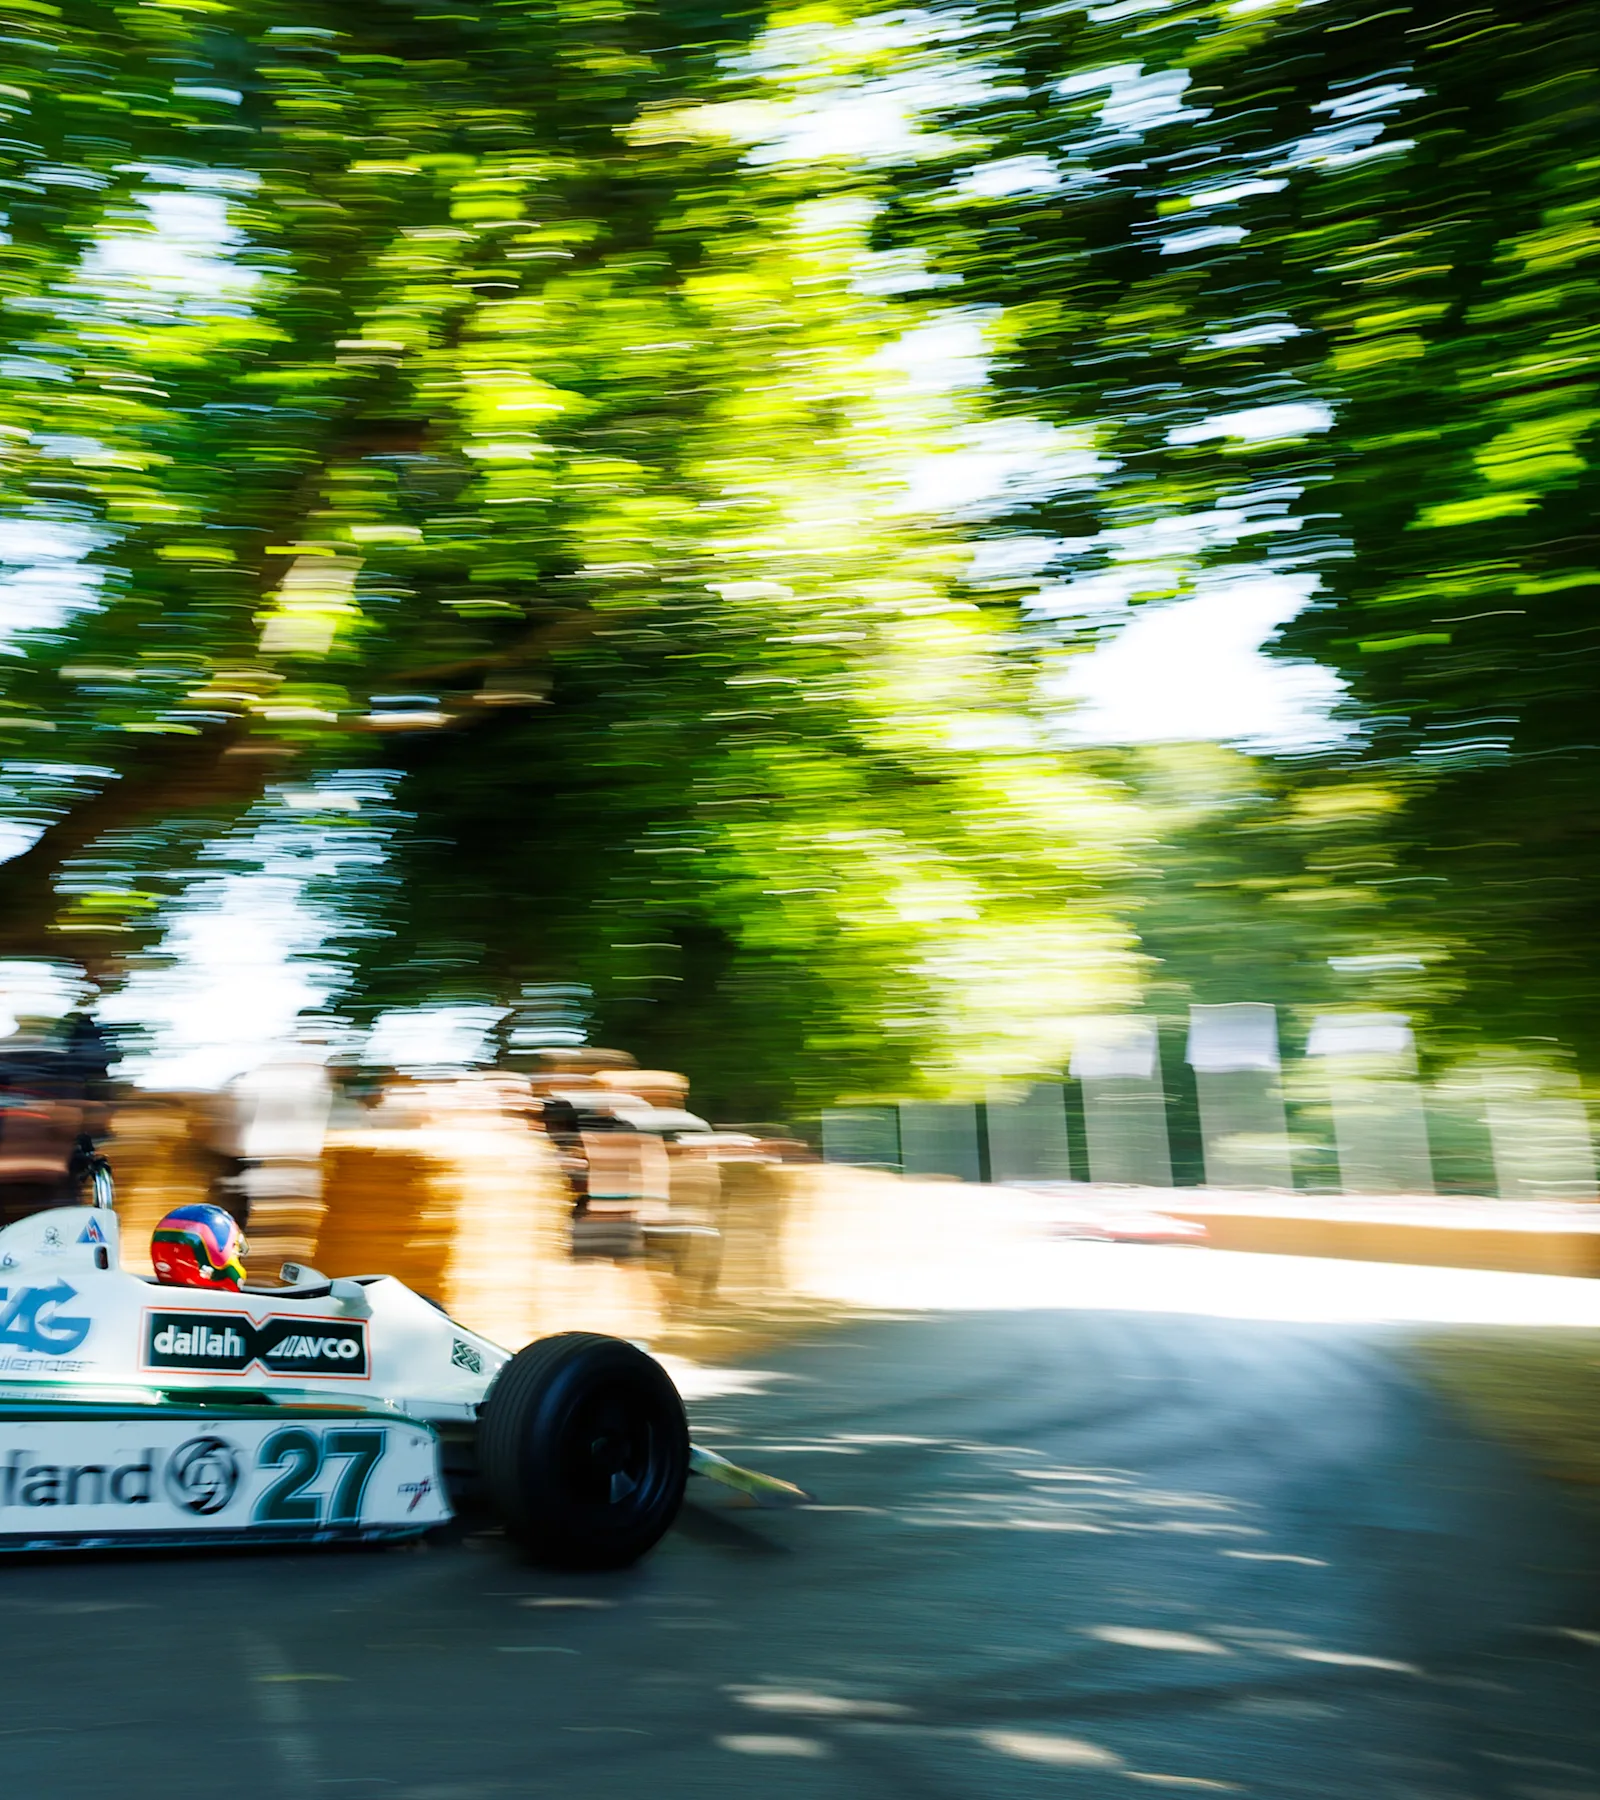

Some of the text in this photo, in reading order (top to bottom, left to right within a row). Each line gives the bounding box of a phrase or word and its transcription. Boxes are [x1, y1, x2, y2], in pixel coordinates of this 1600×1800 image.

[153, 1324, 360, 1359] dallah AVCO
[251, 1425, 388, 1525] 27
